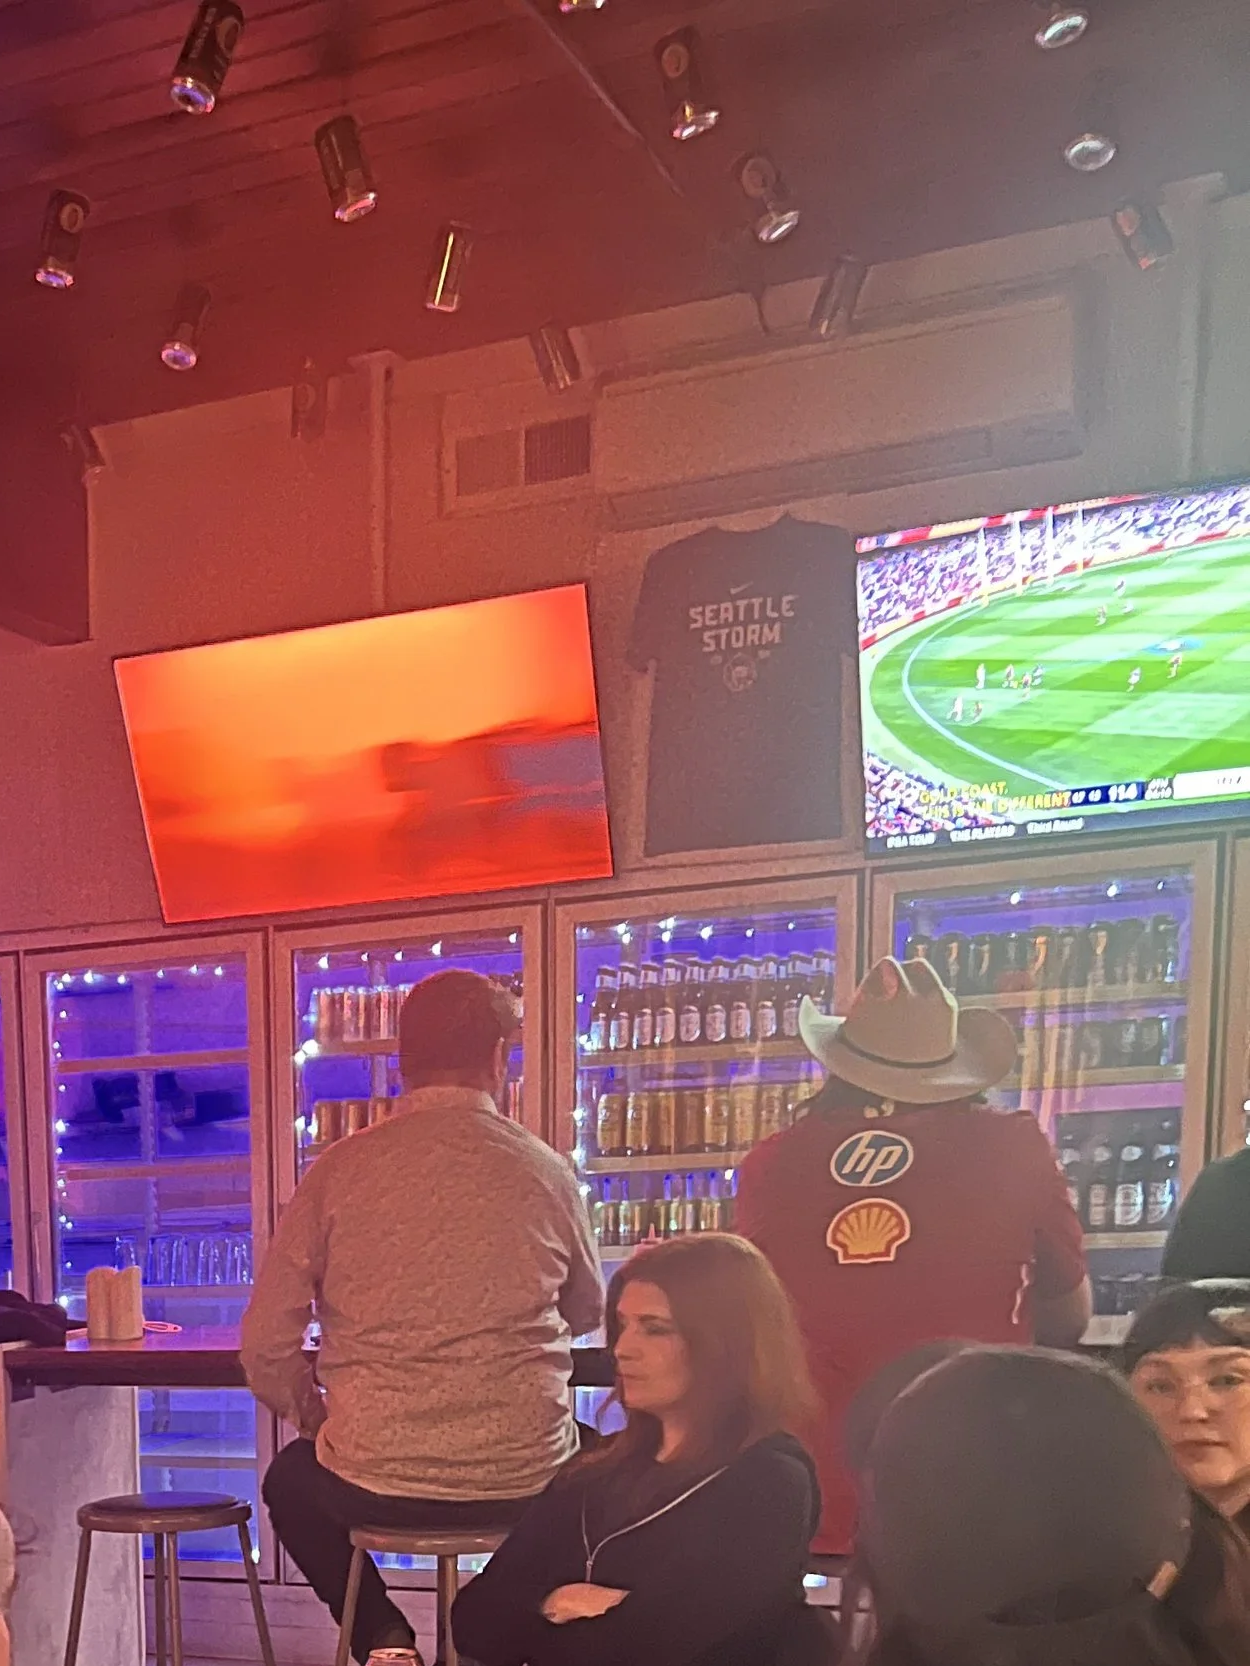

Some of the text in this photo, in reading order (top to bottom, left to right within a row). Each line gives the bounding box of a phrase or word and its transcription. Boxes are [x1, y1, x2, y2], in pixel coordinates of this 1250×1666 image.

[689, 594, 799, 629] SEATTLE
[702, 621, 782, 653] STORM
[838, 1128, 905, 1187] hp
